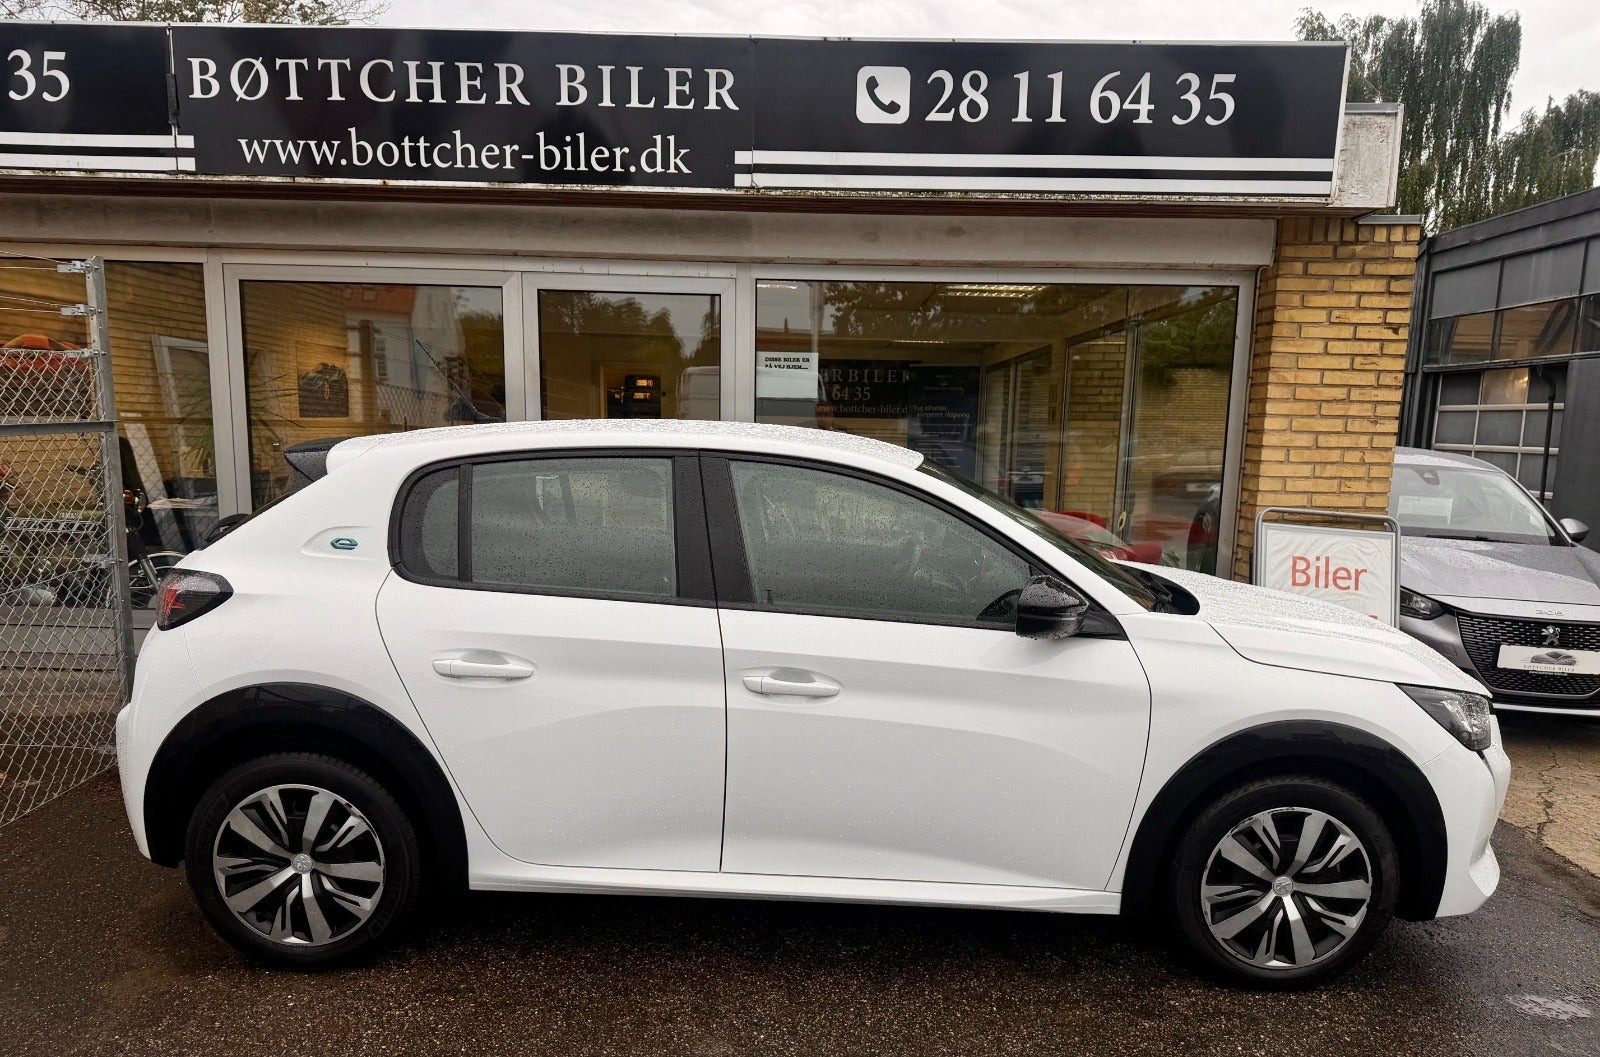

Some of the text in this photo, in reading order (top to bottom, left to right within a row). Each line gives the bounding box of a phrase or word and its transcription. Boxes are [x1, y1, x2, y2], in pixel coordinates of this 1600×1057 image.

[7, 48, 70, 103] 35
[186, 56, 740, 111] BØTTCHER BILER
[924, 69, 1237, 126] 28 11 64 35
[237, 126, 693, 174] www.bottcher-biler.dk
[832, 385, 871, 401] 64 35
[1291, 555, 1368, 591] Biler
